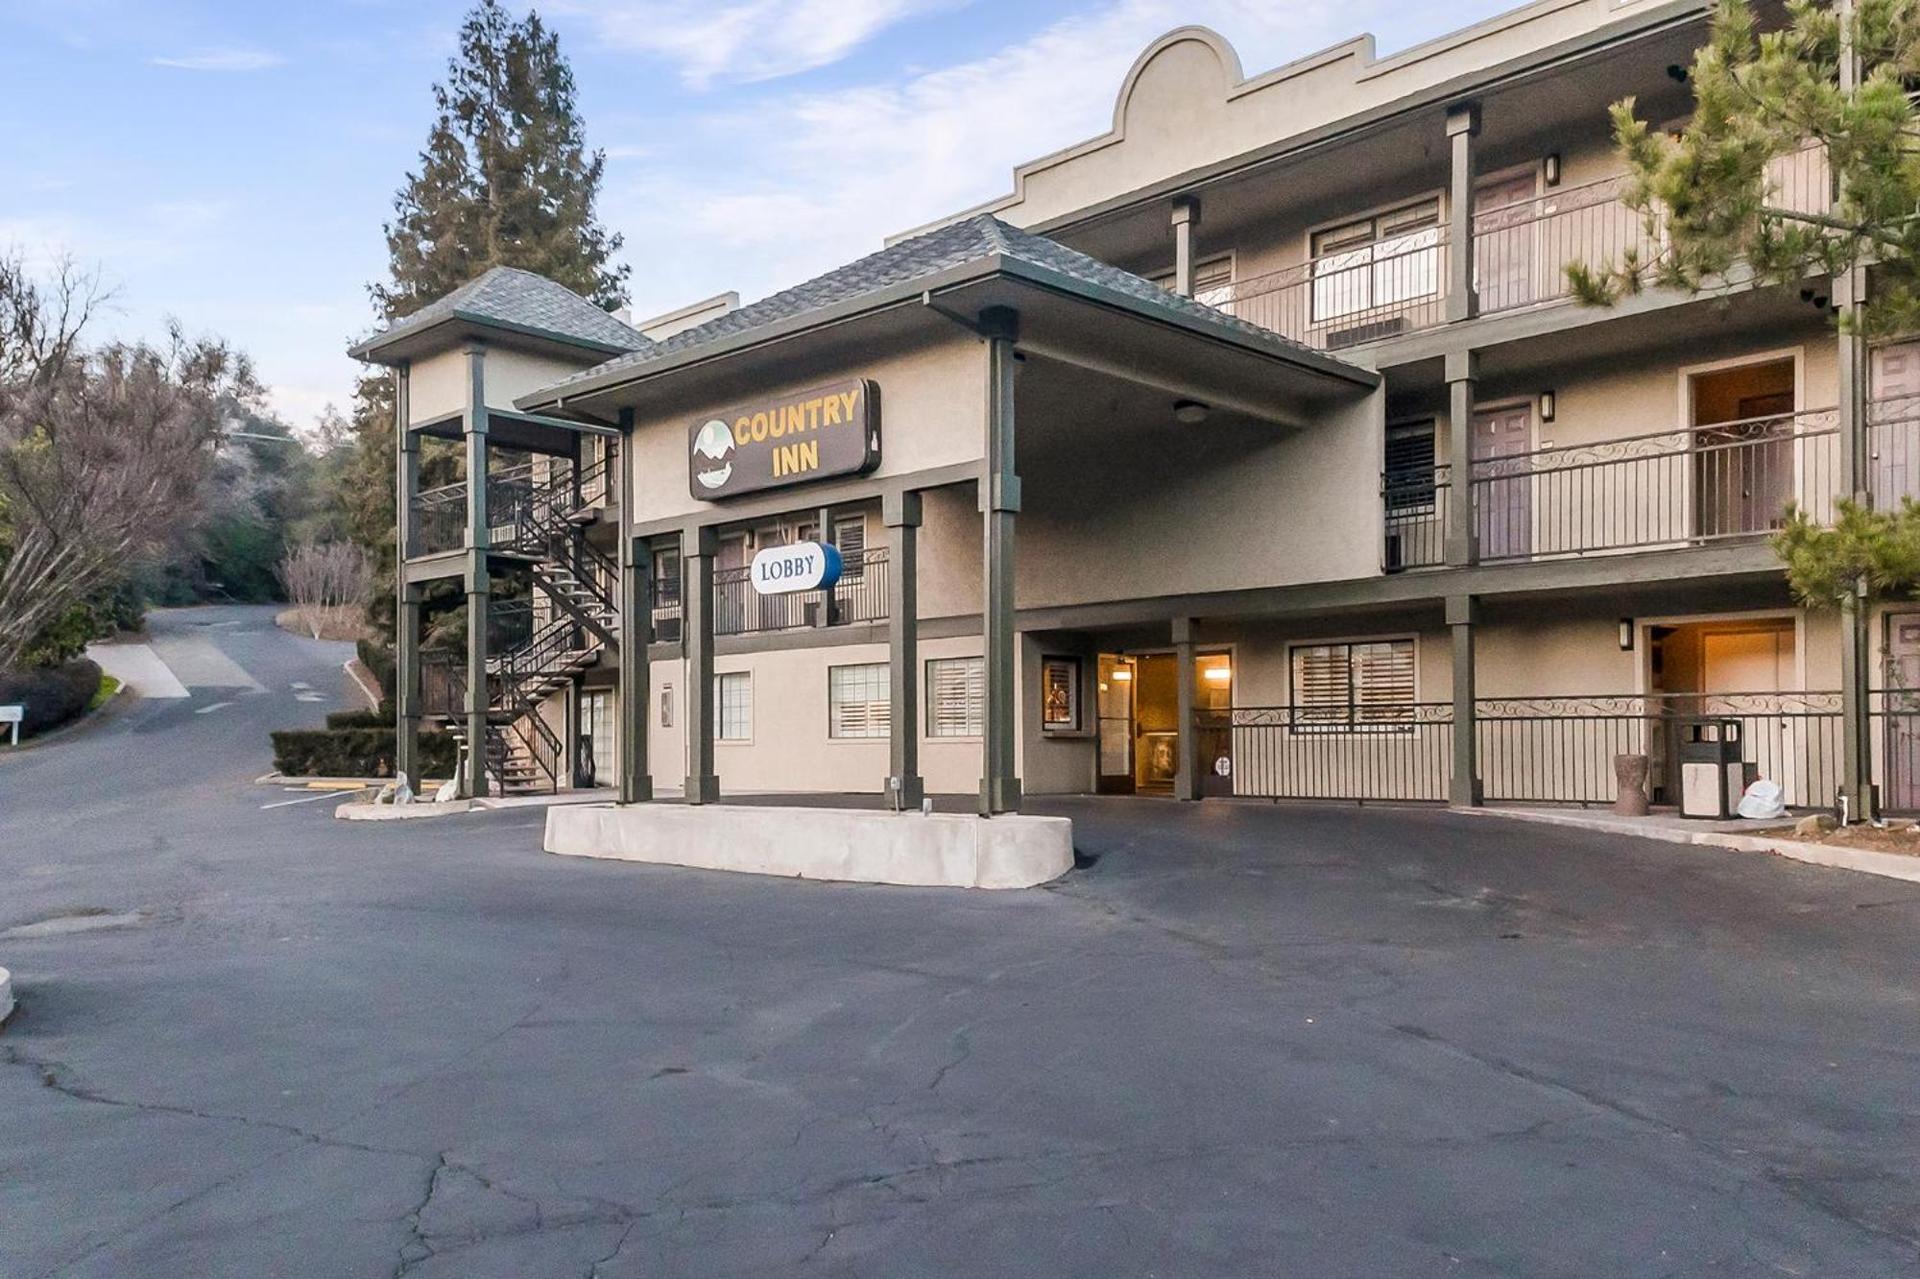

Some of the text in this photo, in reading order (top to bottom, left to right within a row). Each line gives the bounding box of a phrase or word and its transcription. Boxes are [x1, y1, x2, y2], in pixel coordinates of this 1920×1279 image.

[735, 389, 859, 446] COUNTRY
[772, 440, 818, 478] INN
[761, 554, 814, 581] LOBBY
